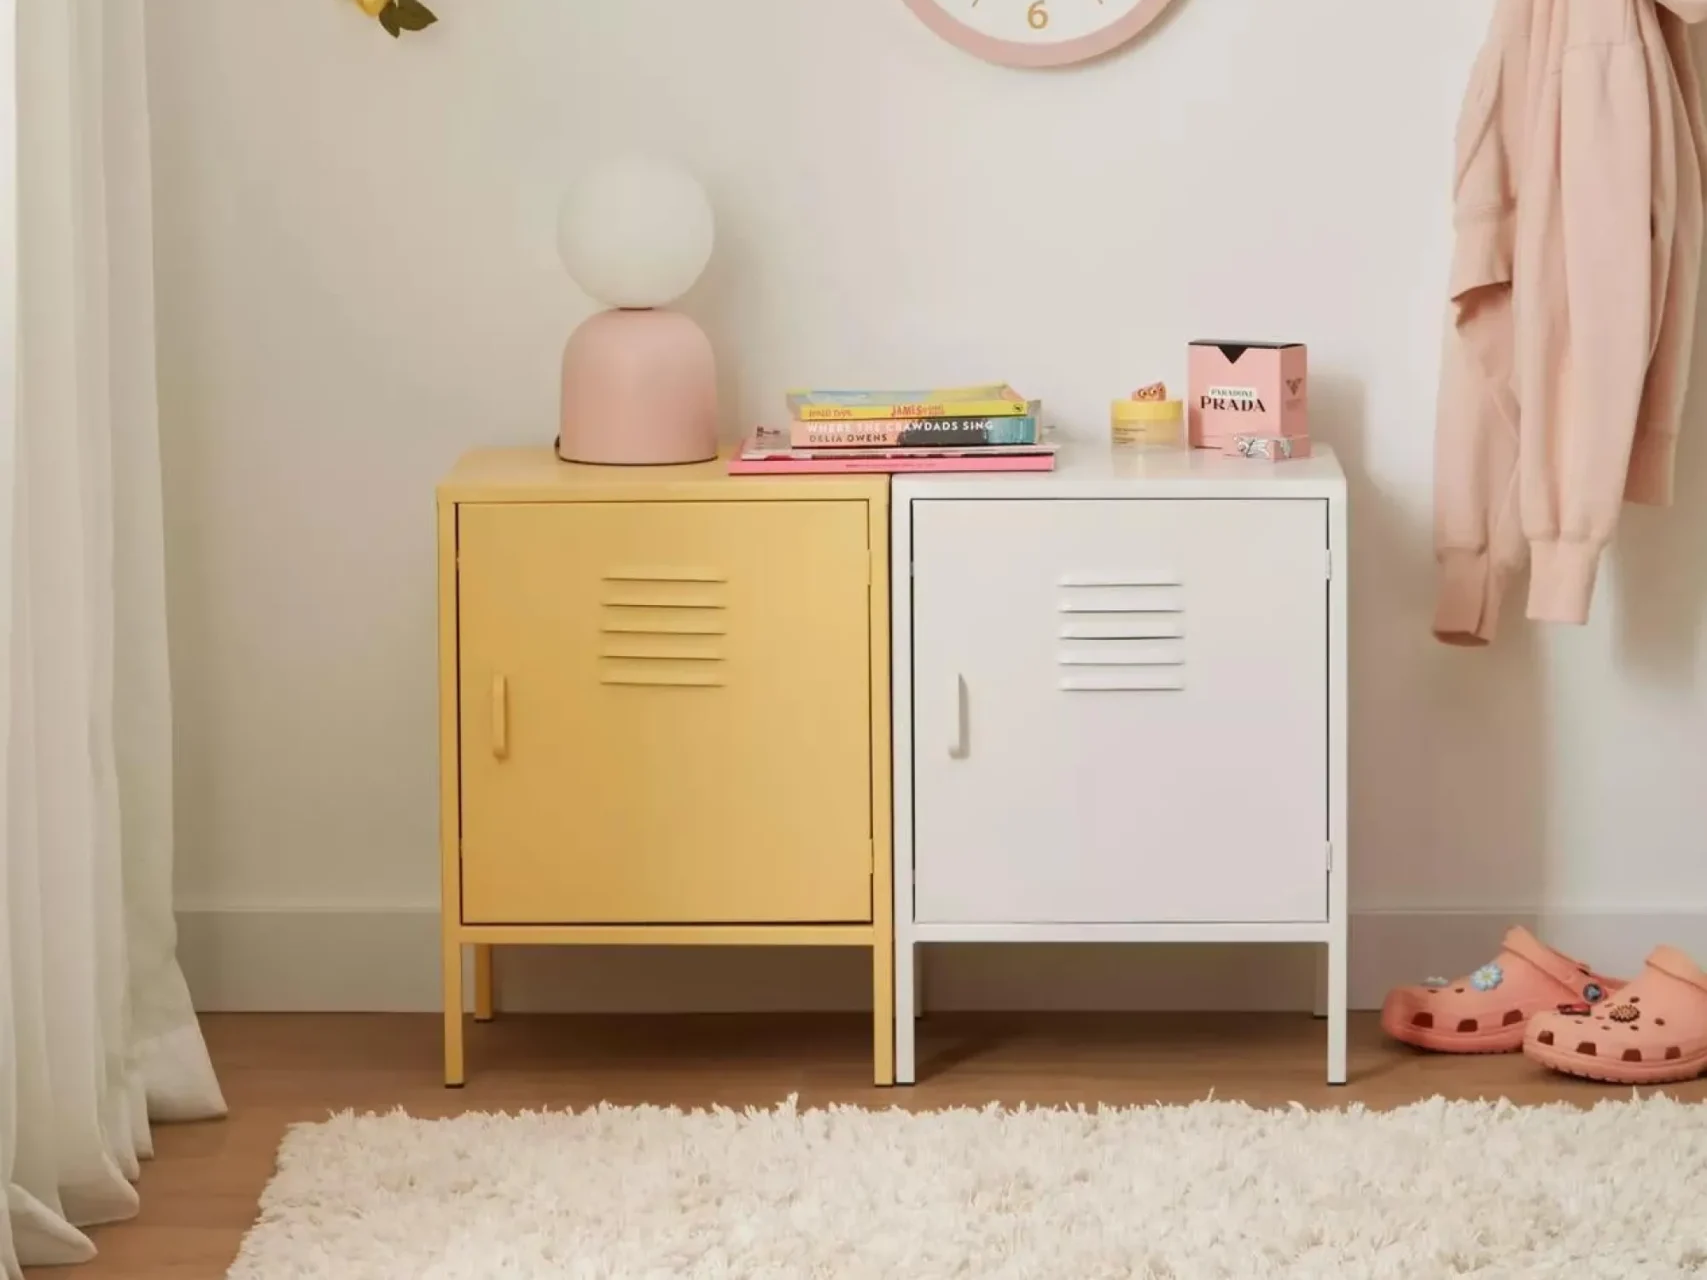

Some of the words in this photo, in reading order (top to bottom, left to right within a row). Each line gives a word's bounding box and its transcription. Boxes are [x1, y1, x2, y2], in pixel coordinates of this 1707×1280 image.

[1027, 0, 1048, 29] 6
[1200, 395, 1266, 412] PRADA
[807, 422, 851, 433] WHERE
[962, 420, 994, 432] SING
[809, 434, 843, 443] DELIA
[847, 433, 888, 443] OWENS
